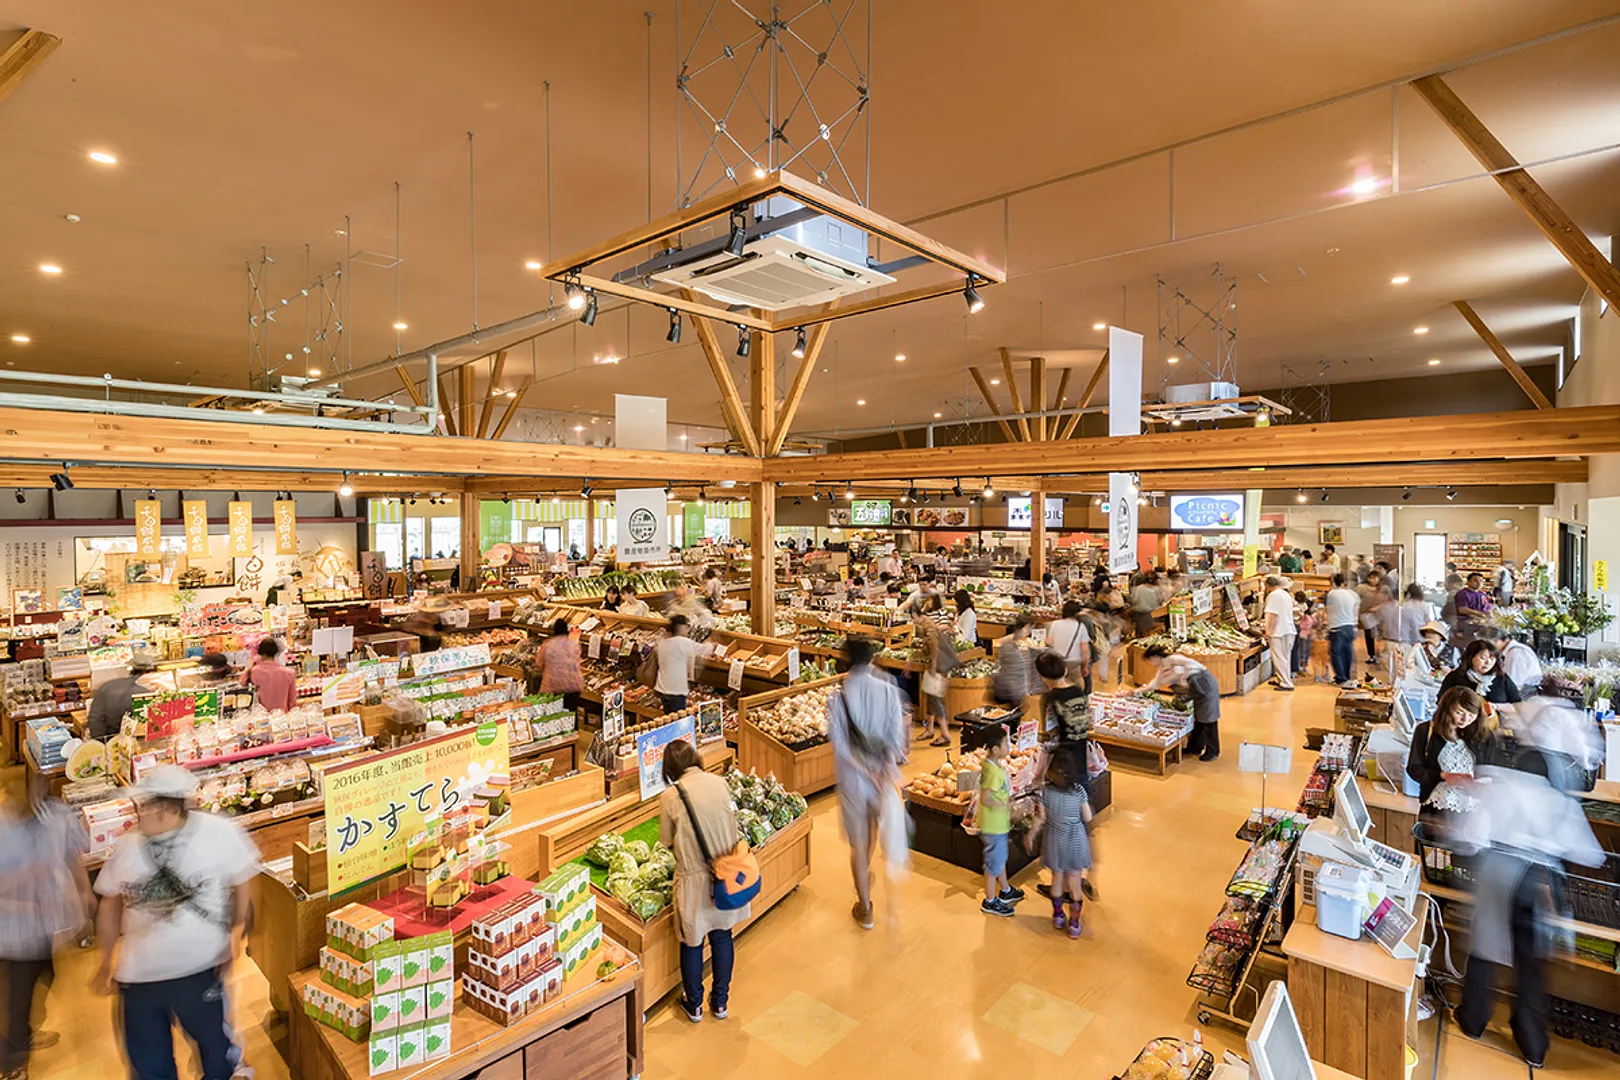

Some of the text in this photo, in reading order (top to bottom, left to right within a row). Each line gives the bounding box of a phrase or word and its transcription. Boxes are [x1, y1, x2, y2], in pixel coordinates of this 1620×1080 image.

[1188, 501, 1227, 509] Picnic
[1188, 514, 1214, 523] Cafe
[337, 777, 459, 852] かすてら
